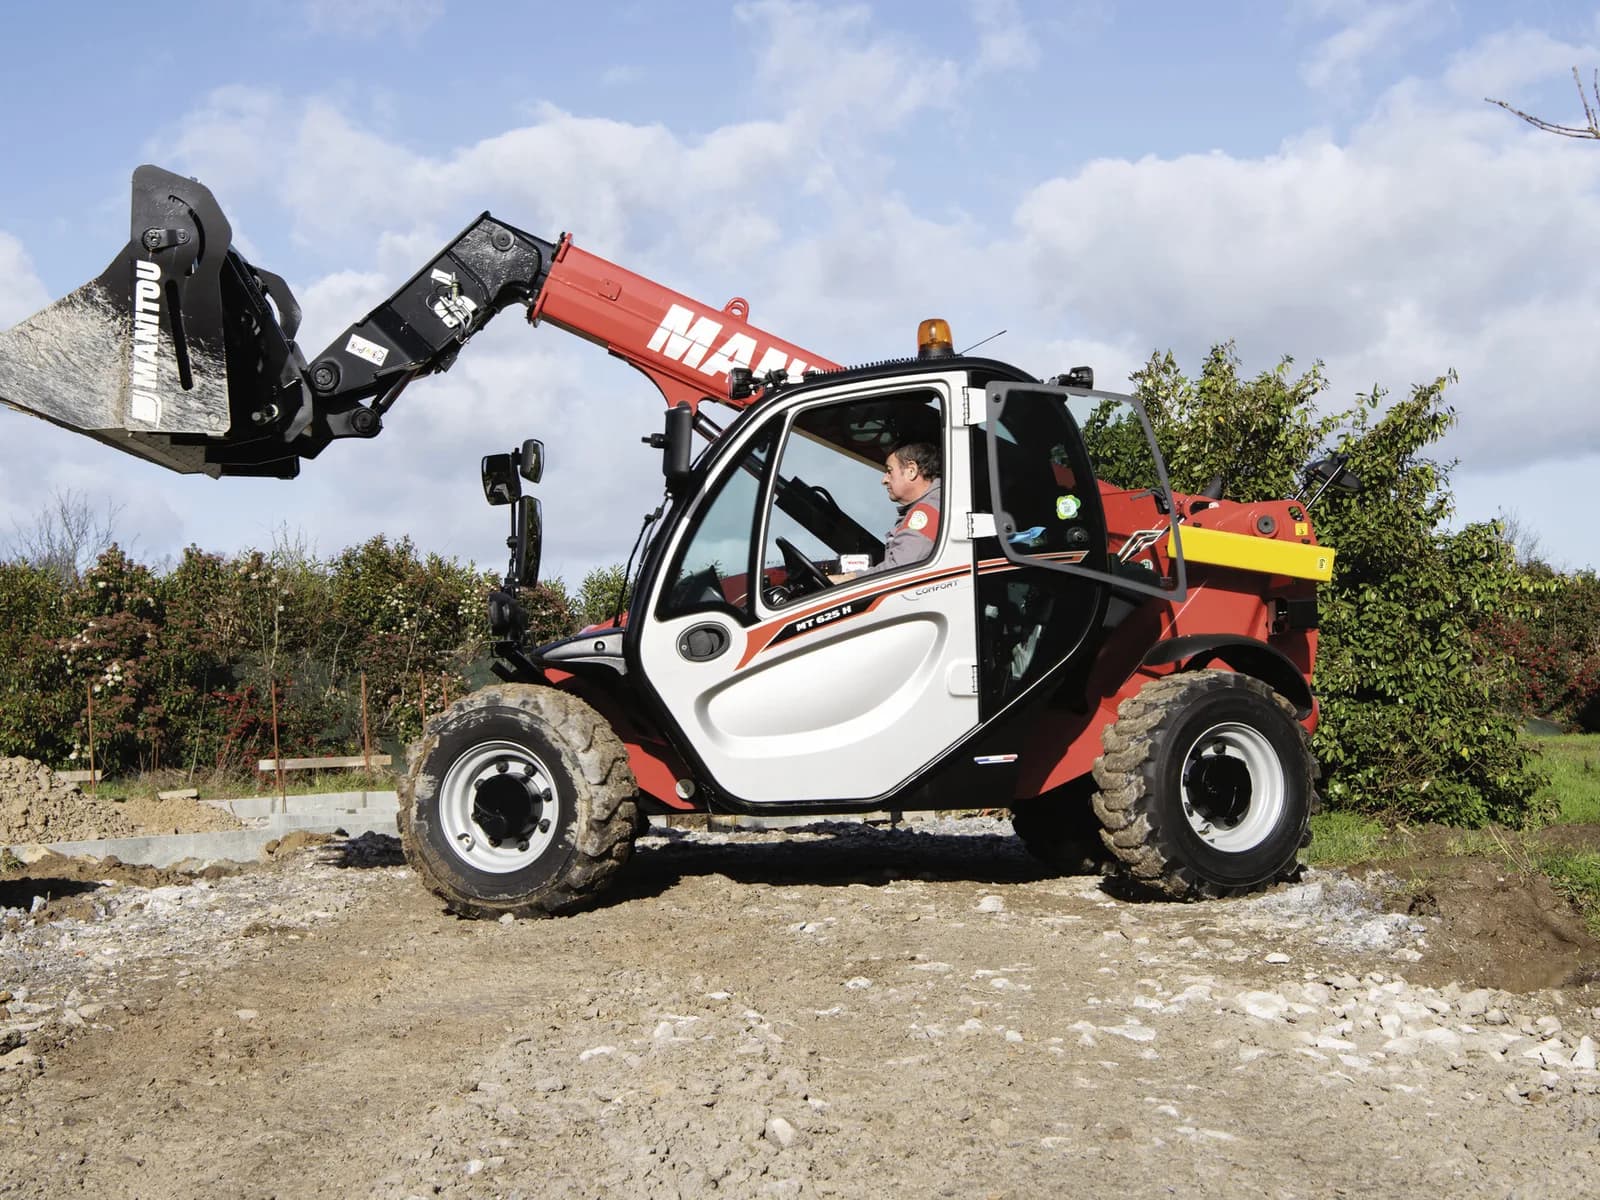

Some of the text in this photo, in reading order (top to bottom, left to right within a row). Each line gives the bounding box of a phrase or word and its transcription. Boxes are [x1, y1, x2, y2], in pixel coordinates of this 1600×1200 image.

[133, 259, 162, 389] MANITOU
[915, 580, 959, 596] COMFORT
[796, 605, 852, 632] MT 625 H
